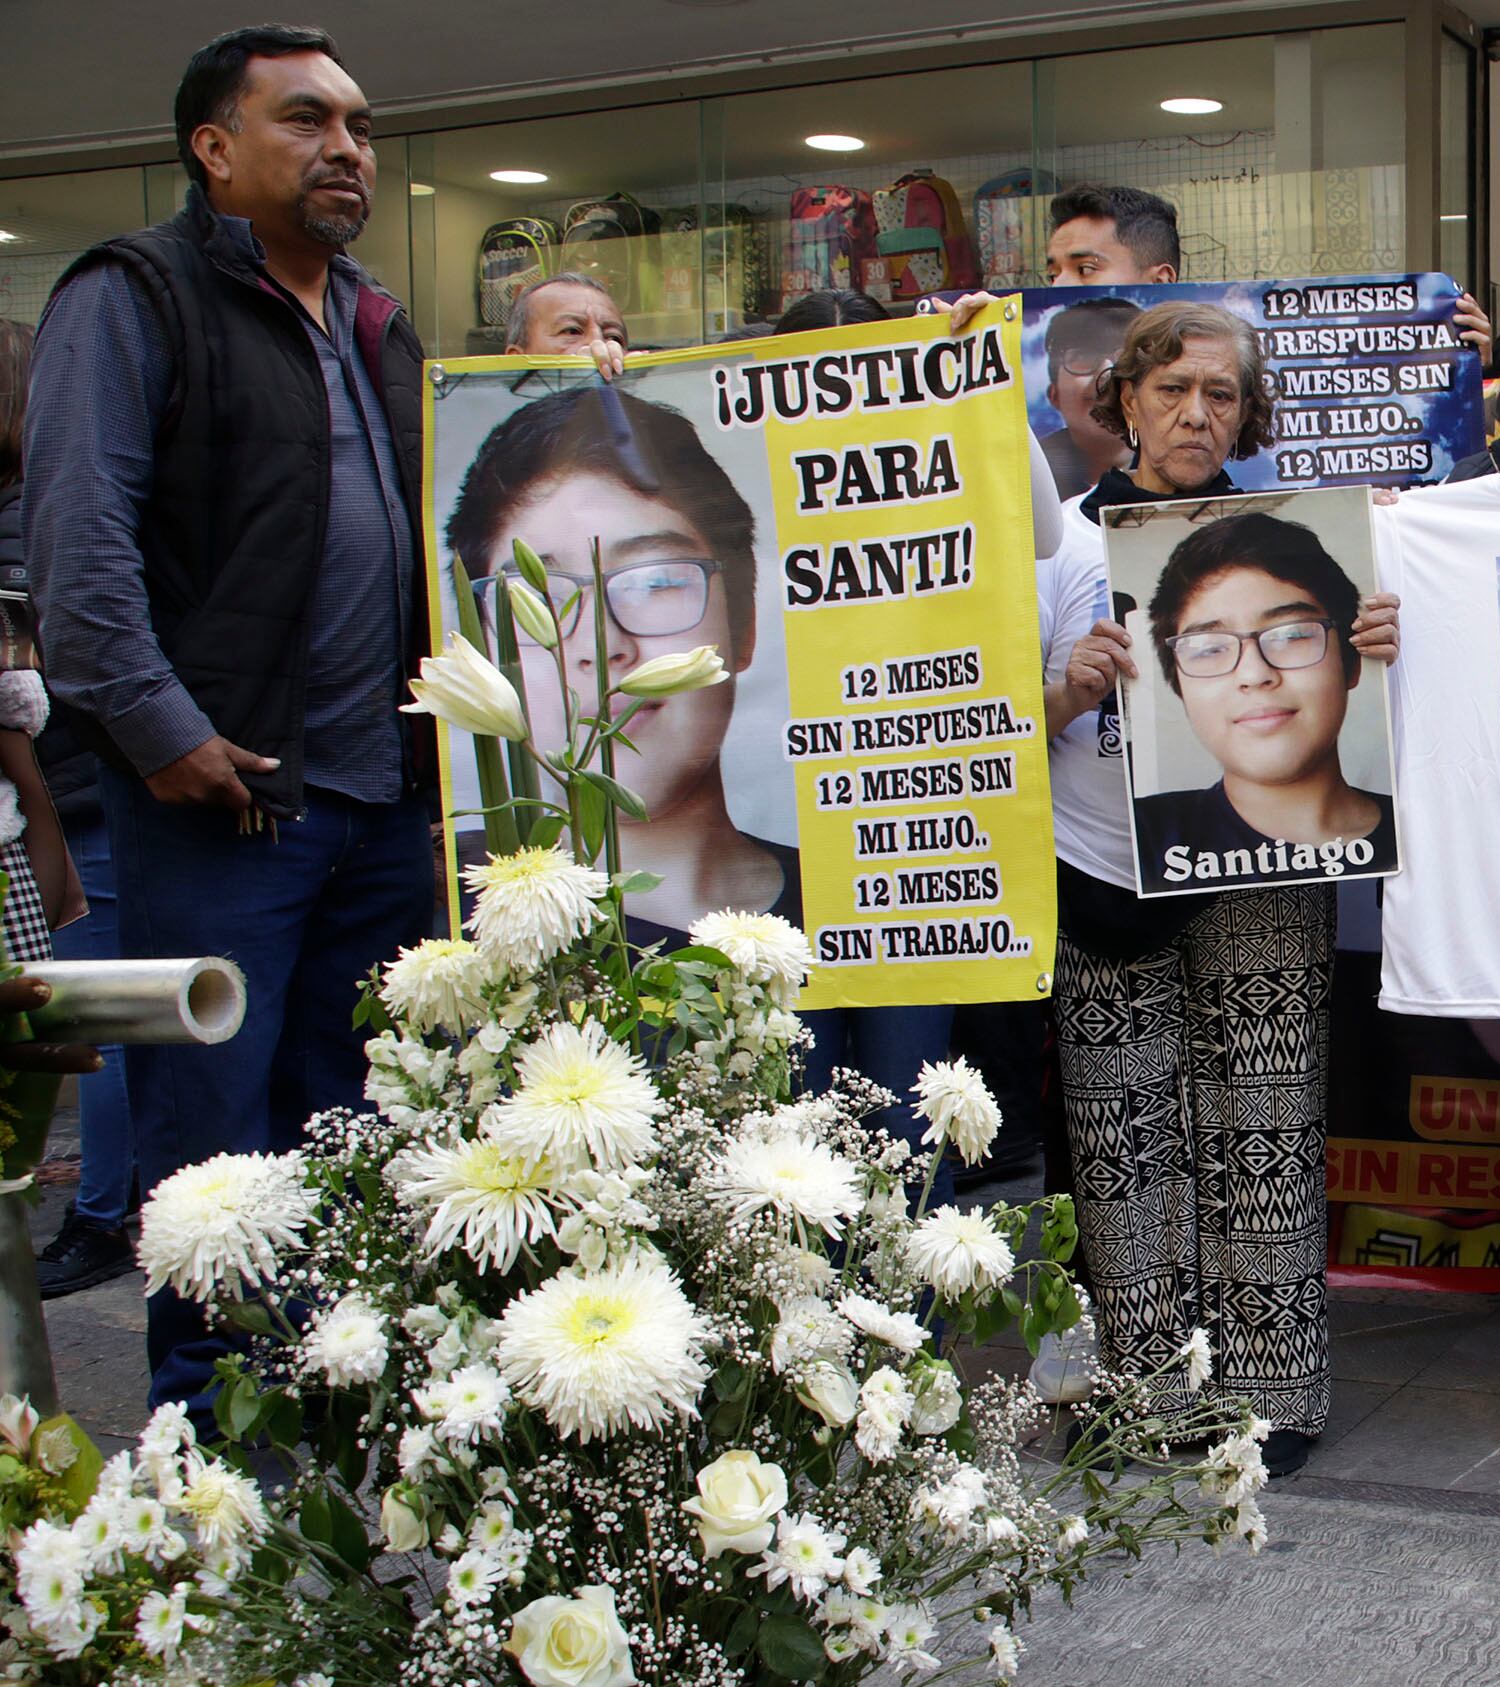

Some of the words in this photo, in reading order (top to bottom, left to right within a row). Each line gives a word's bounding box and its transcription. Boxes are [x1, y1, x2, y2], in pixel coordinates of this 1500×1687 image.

[866, 262, 885, 280] 30
[1267, 292, 1299, 316] 12
[1308, 286, 1414, 314] MESES
[1275, 324, 1468, 356] RESPUESTA..
[715, 330, 1010, 426] ¡JUSTICIA
[1284, 367, 1391, 397] MESES
[1399, 363, 1450, 391] SIN
[1281, 411, 1321, 437] MI
[1328, 407, 1418, 434] HIJO..
[795, 439, 959, 510] PARA
[1281, 454, 1314, 477] 12
[1321, 444, 1429, 475] MESES
[786, 527, 972, 606] SANTI!
[845, 668, 878, 698] 12
[887, 652, 979, 694] MESES
[788, 721, 842, 756] SIN
[852, 702, 1032, 750] RESPUESTA..
[819, 776, 852, 805] 12
[861, 763, 963, 802] MESES
[970, 757, 1013, 793] SIN
[858, 822, 898, 855] MI
[906, 815, 987, 851] HIJO..
[1163, 837, 1374, 882] Santiago
[858, 878, 890, 907] 12
[898, 868, 998, 904] MESES
[819, 929, 872, 962] SIN
[882, 920, 1028, 958] TRABAJO...
[1418, 1086, 1499, 1133] UN
